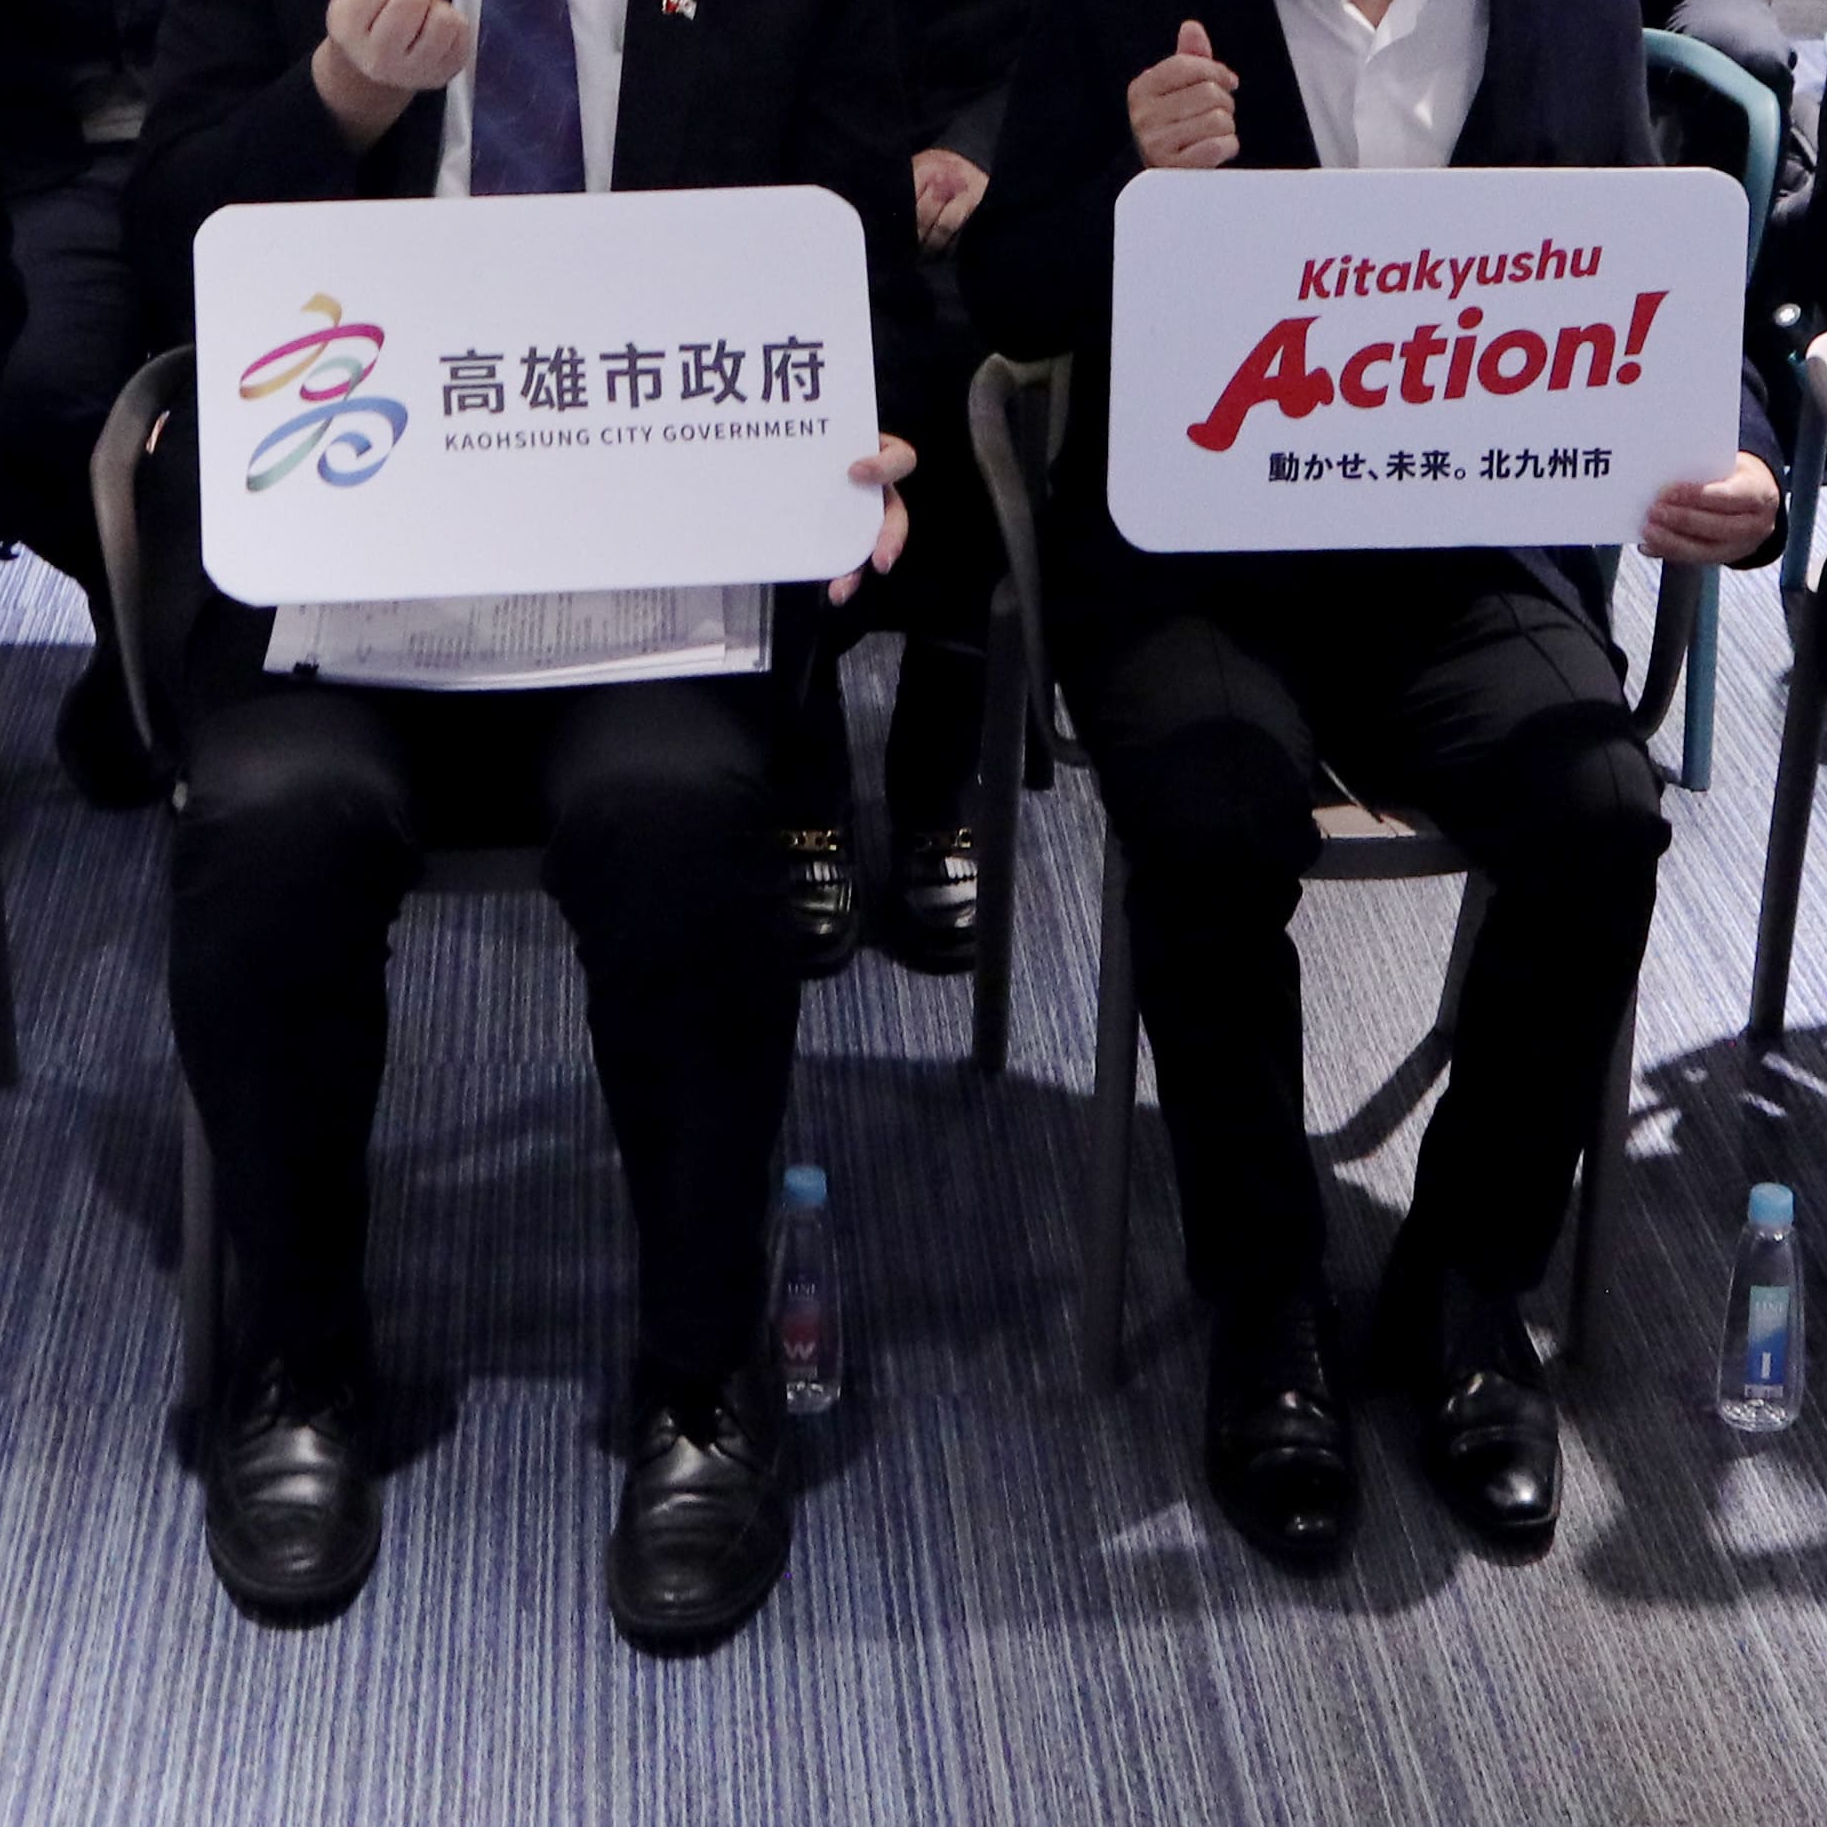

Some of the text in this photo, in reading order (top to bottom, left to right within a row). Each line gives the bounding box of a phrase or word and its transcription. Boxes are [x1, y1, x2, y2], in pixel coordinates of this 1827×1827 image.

[1297, 237, 1603, 301] Kitakyushu
[439, 335, 826, 417] 高雄市政府
[1186, 289, 1670, 452] Action!
[444, 417, 831, 453] KAOHSIUNG CITY GOVERNMENT
[1268, 448, 1613, 484] 動かせ、未来。北九州市
